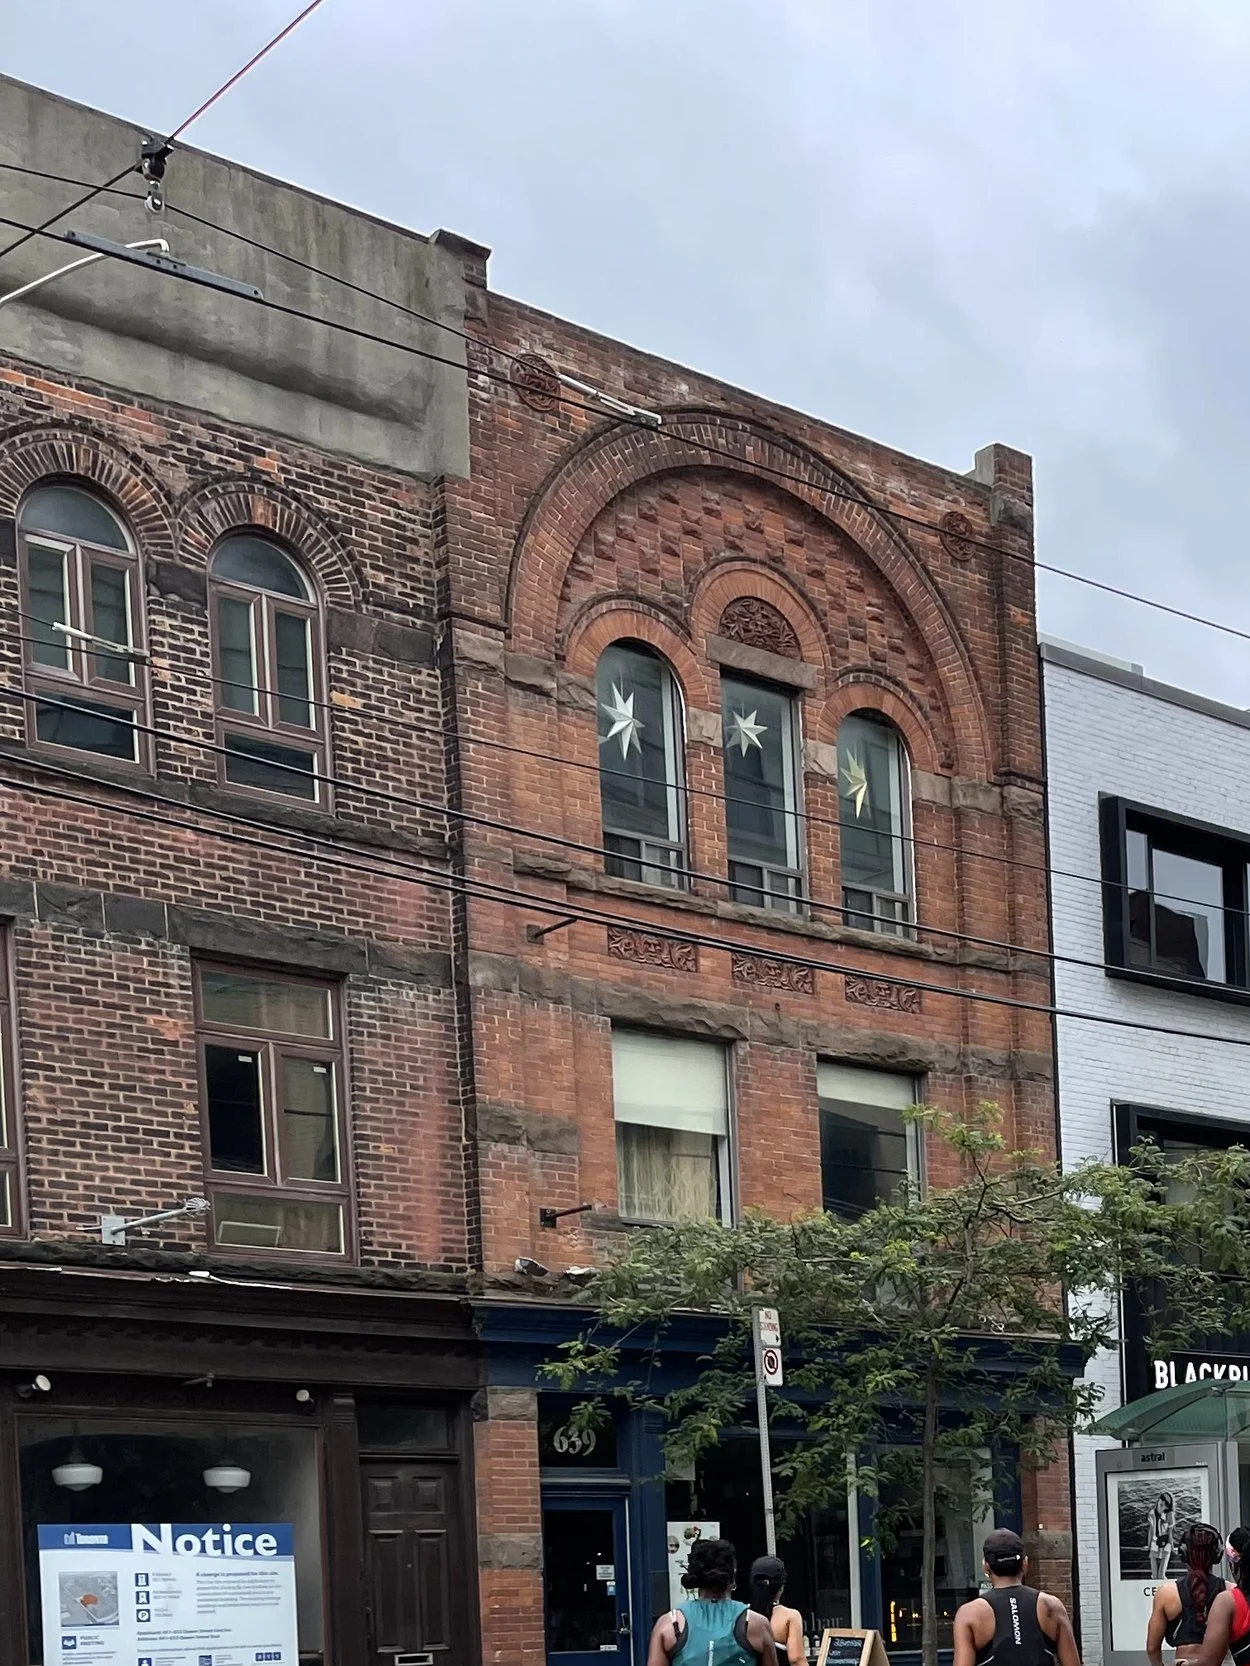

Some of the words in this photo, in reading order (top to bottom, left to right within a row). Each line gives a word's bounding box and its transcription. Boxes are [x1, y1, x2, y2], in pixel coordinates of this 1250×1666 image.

[553, 1426, 596, 1456] 639
[1140, 1452, 1165, 1463] astral
[131, 1523, 277, 1556] Notice
[1009, 1597, 1021, 1645] SALOMON
